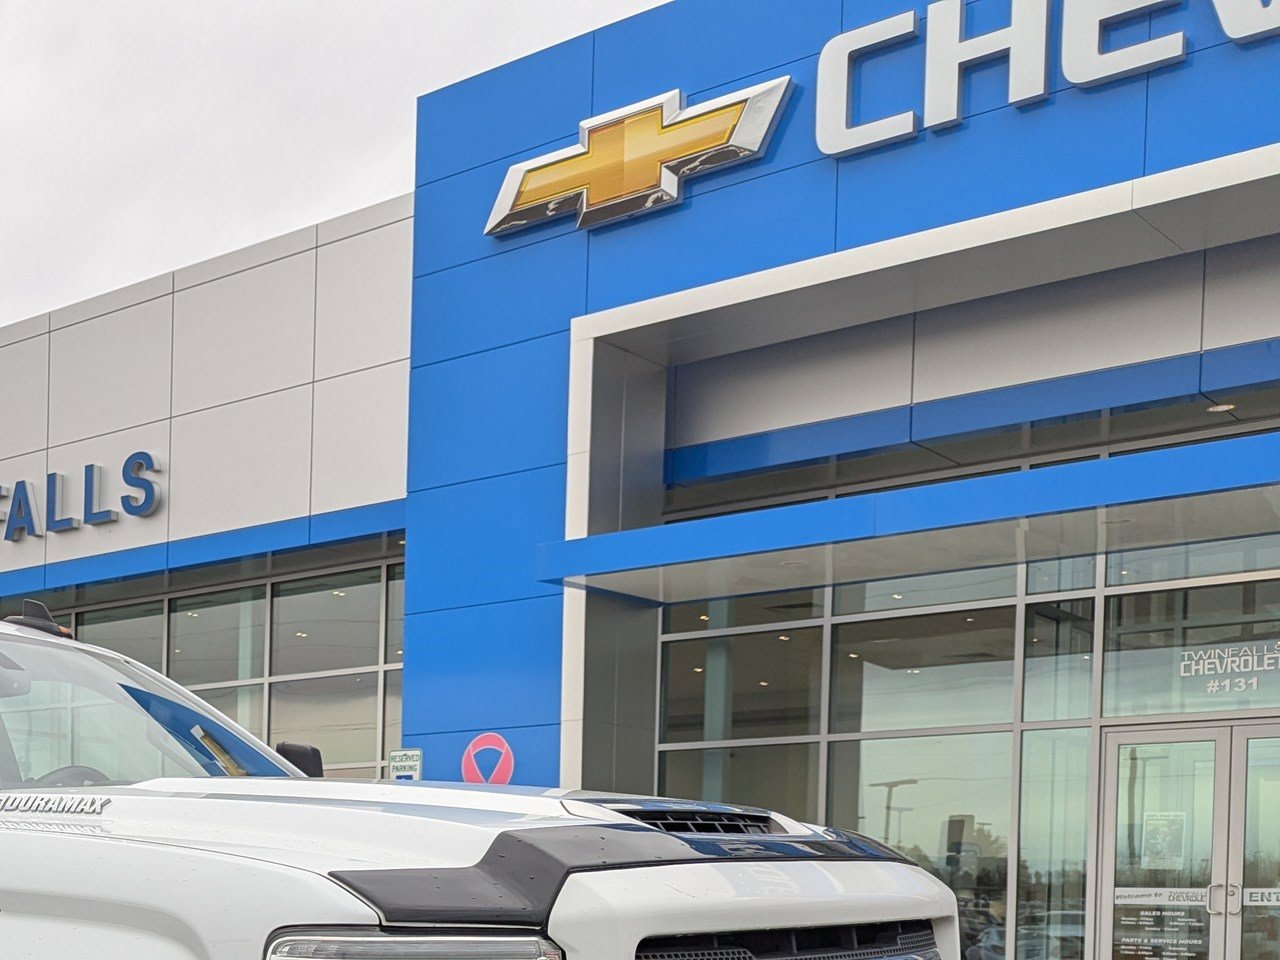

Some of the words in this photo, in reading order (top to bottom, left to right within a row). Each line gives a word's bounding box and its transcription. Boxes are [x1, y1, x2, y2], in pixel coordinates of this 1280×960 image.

[1206, 677, 1259, 694] #131
[391, 754, 420, 763] RESERVED
[392, 764, 418, 773] PARKING
[4, 796, 112, 814] DURAMAX
